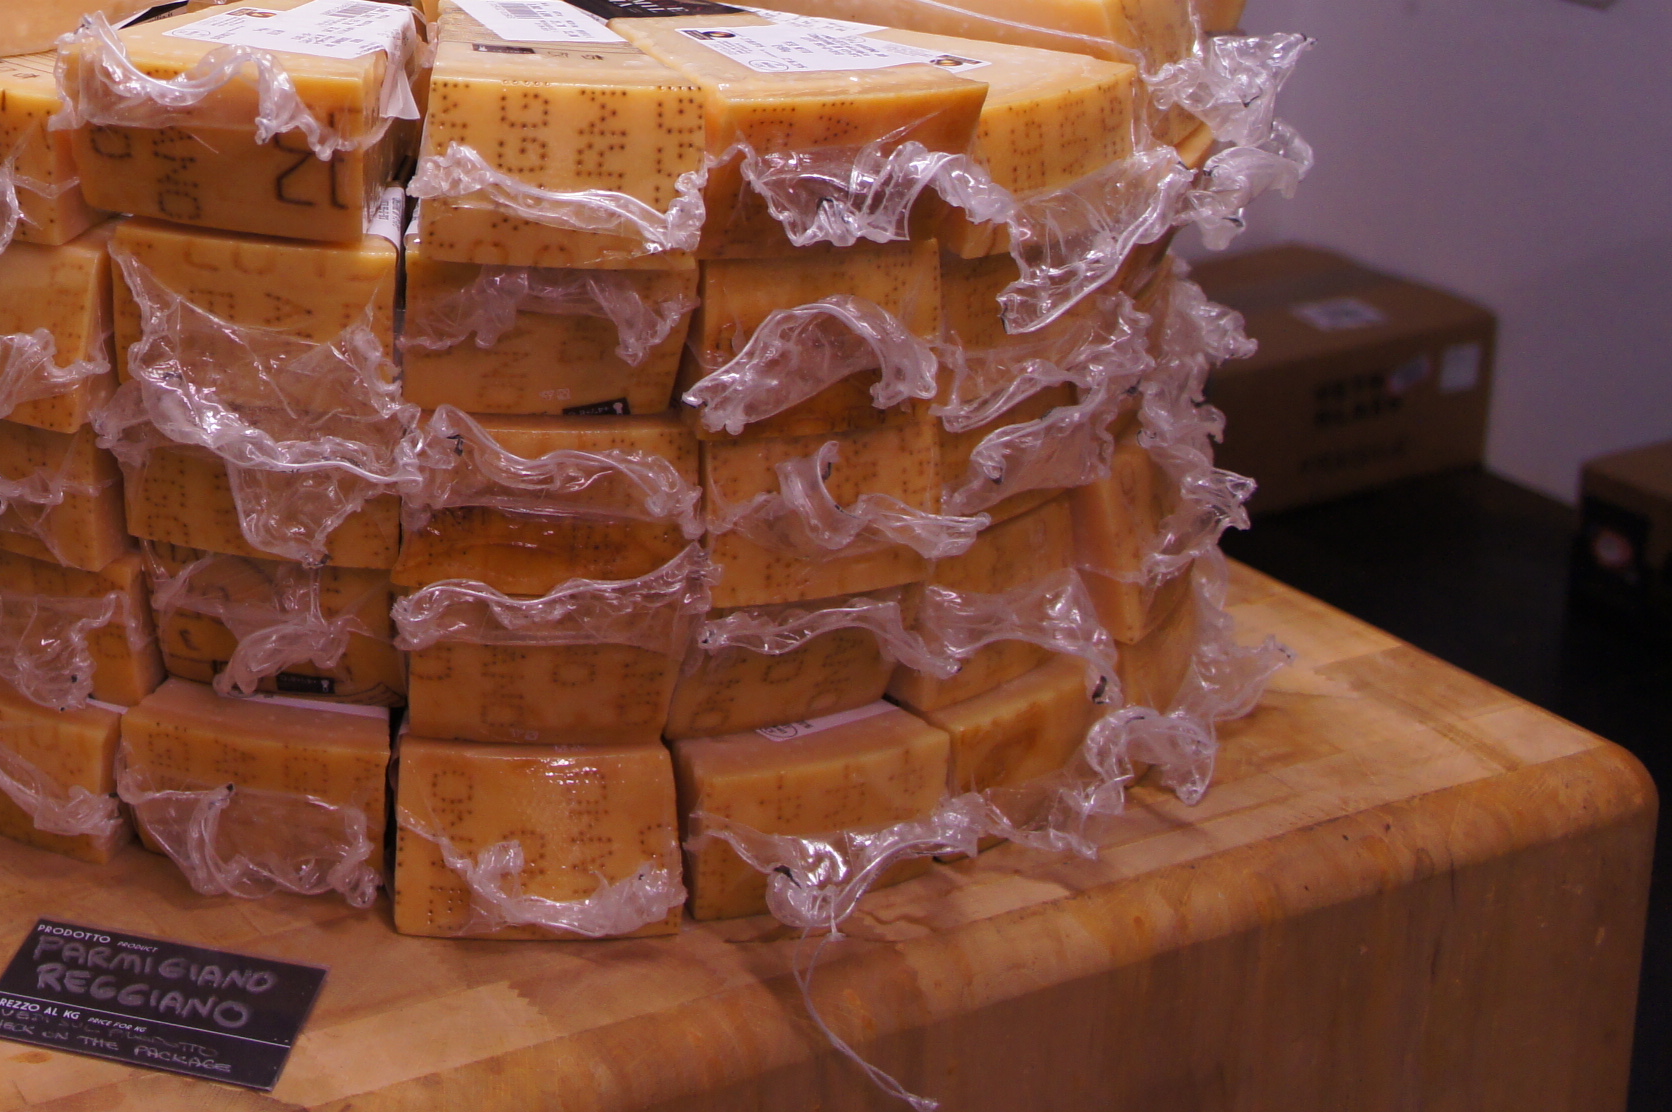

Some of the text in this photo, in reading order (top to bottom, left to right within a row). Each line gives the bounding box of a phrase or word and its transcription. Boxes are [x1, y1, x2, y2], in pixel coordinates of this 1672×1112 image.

[37, 924, 159, 953] PRODOTTO PRODUCT
[32, 935, 275, 993] PARMIGIANO
[35, 963, 251, 1029] REGGIANO
[44, 1006, 58, 1016] AL
[63, 1009, 81, 1020] KG
[87, 1017, 112, 1027] PRICE
[113, 1021, 133, 1032] FOR
[134, 1025, 148, 1033] KG
[42, 1031, 69, 1041] ON
[76, 1035, 120, 1051] THE
[133, 1045, 232, 1073] PACKAGE
